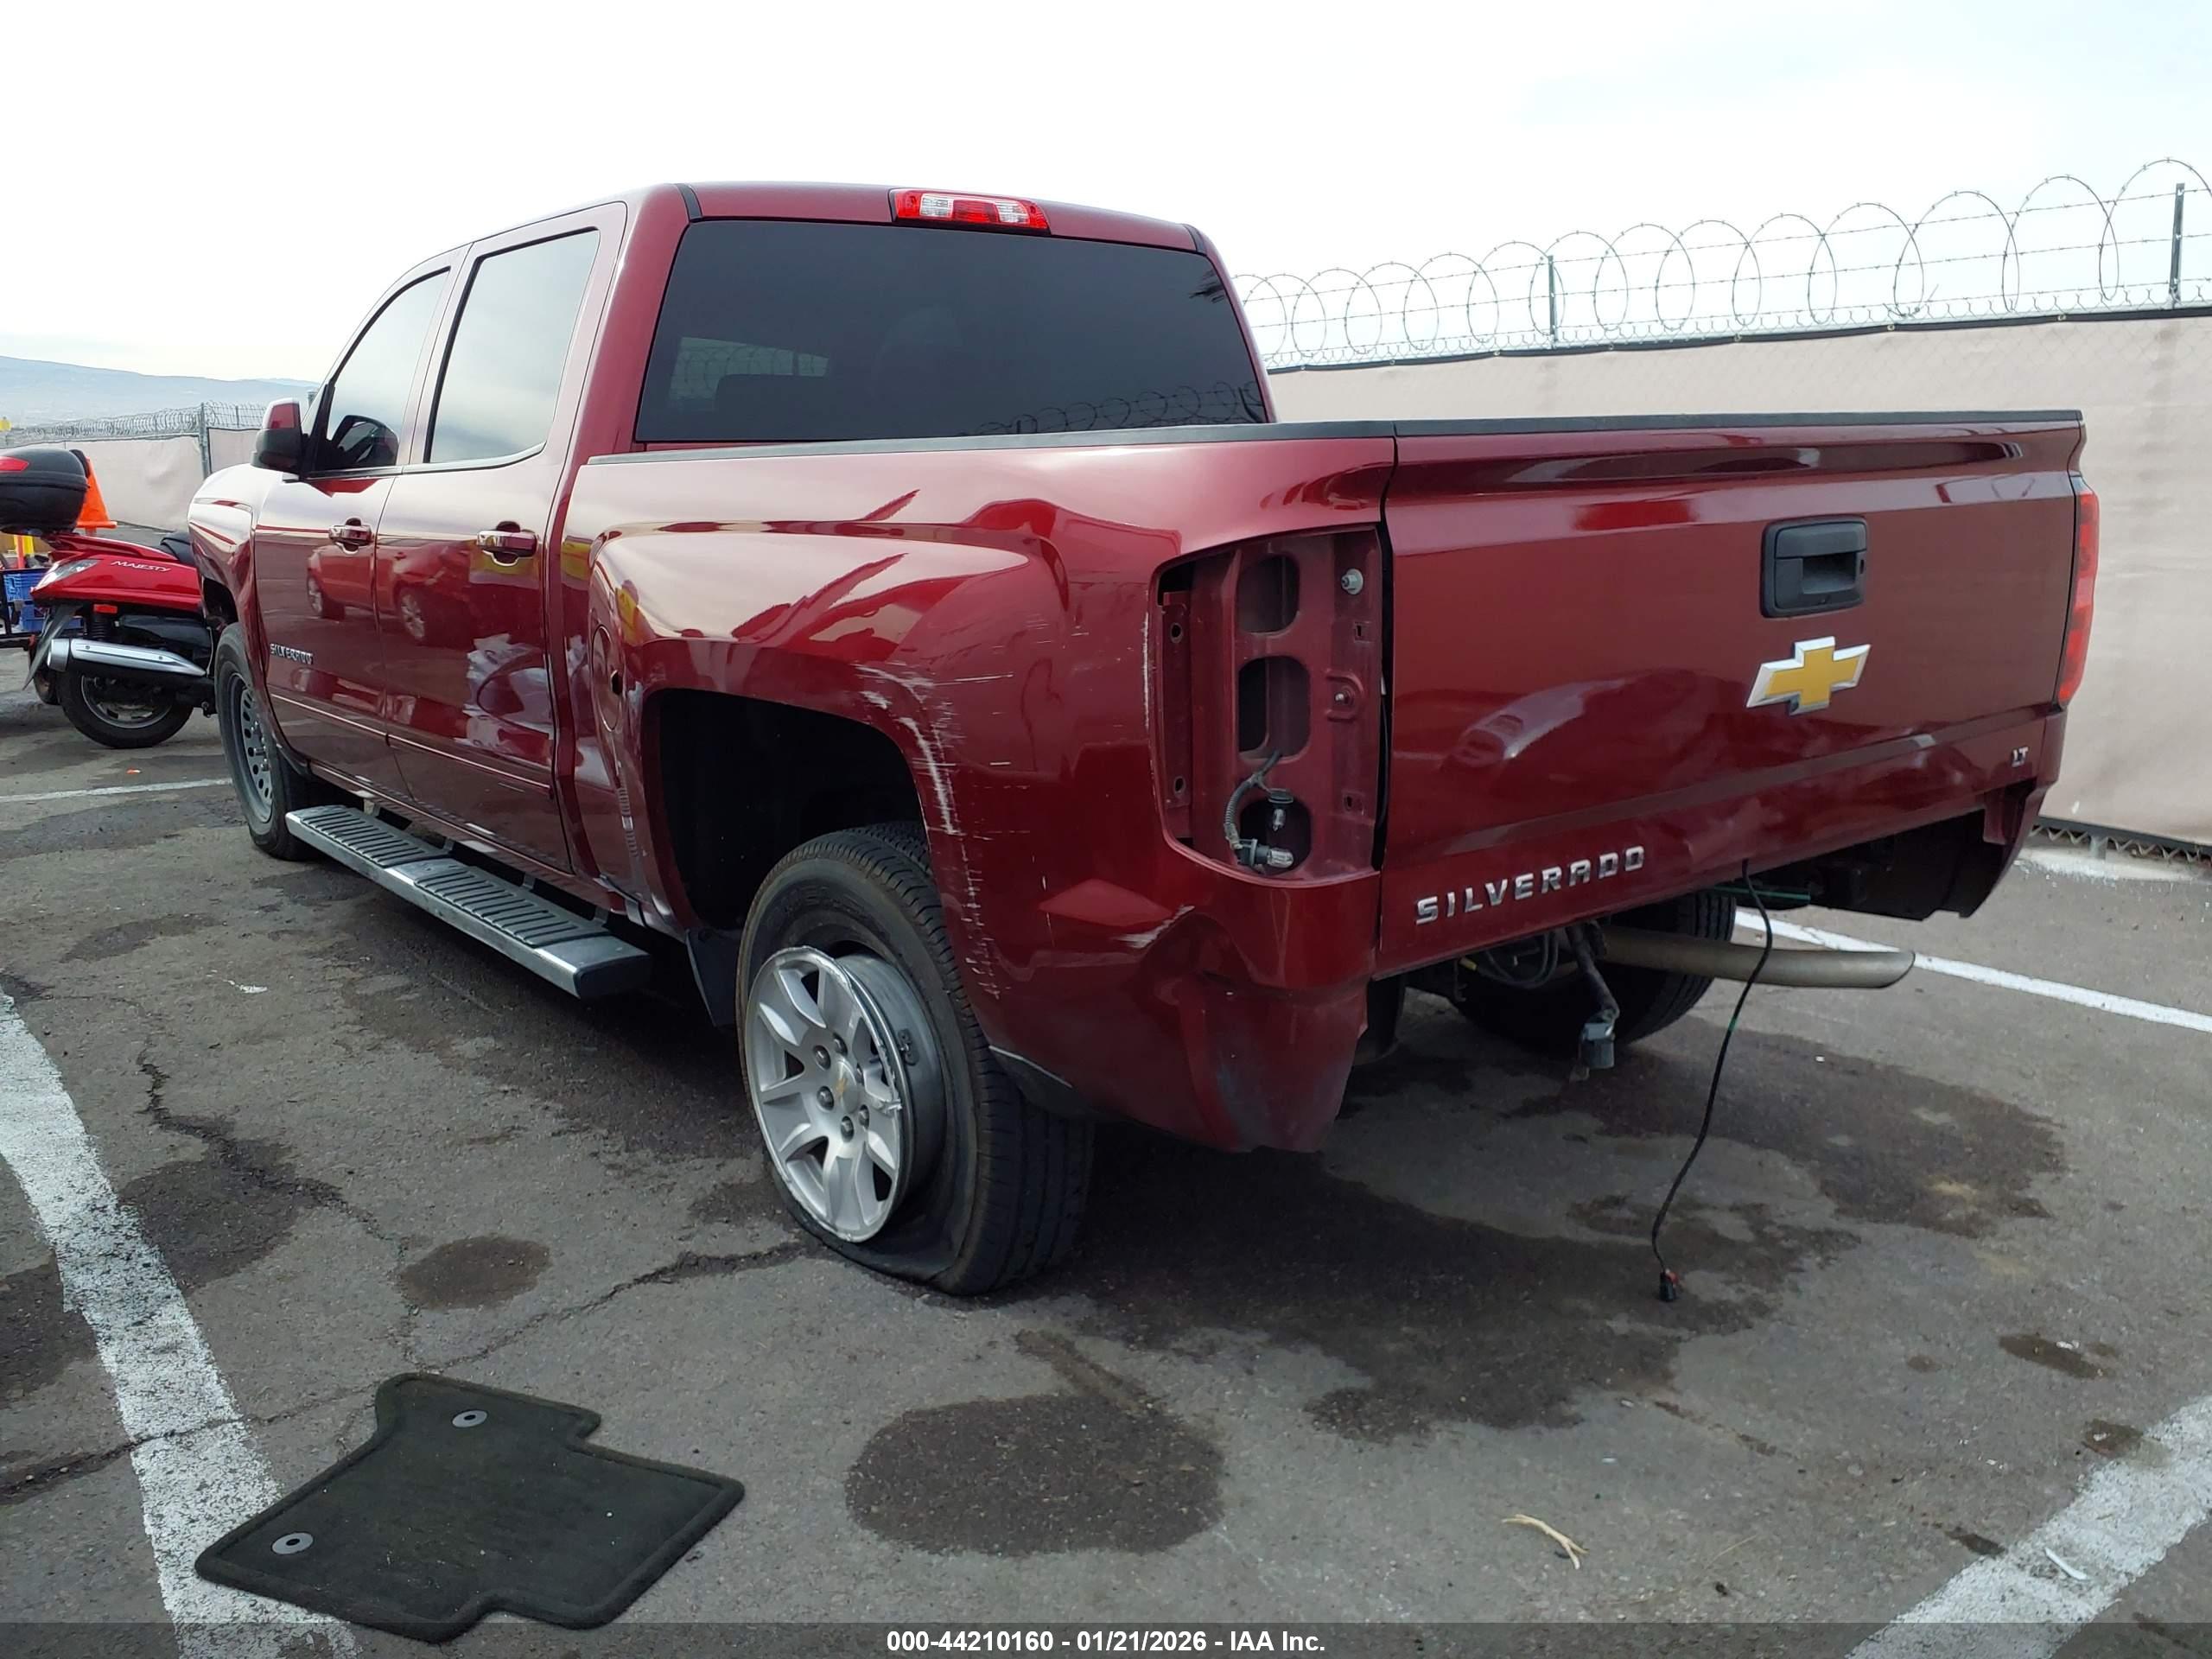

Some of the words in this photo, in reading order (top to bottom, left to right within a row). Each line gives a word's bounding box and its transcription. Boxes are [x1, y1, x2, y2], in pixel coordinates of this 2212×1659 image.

[110, 560, 172, 572] MAJESTY
[2011, 746, 2029, 767] LT
[1415, 845, 1645, 925] SILVERADO
